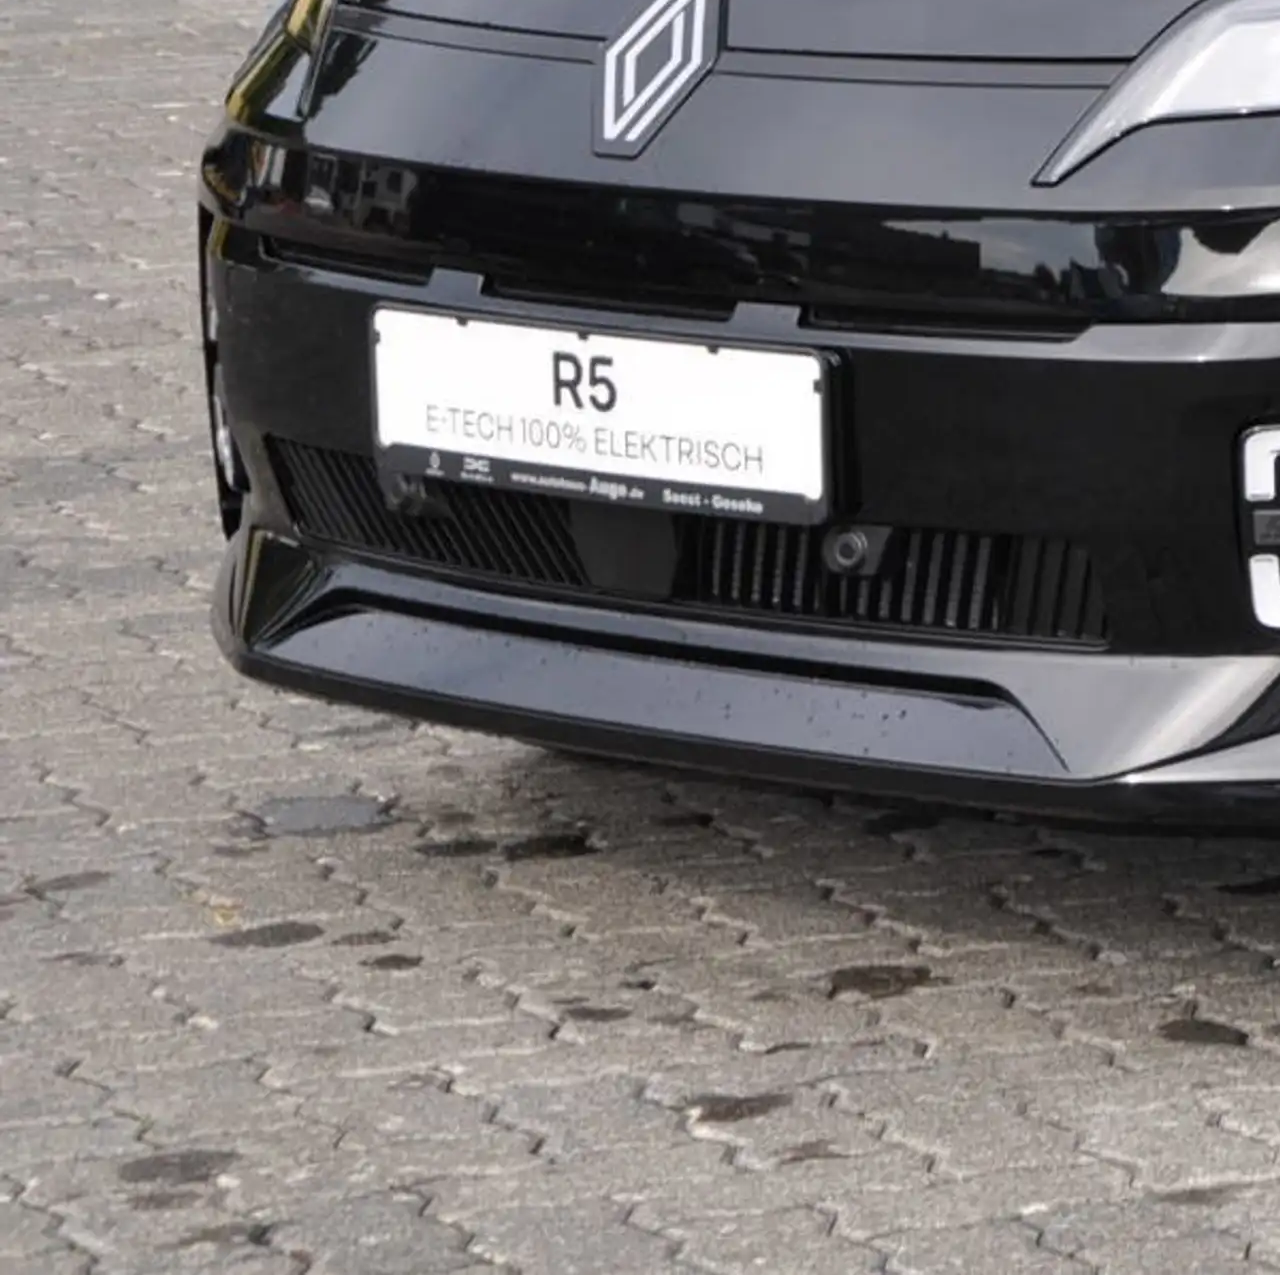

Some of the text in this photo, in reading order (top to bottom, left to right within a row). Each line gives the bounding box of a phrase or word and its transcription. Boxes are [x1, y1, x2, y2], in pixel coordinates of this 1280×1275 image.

[552, 350, 617, 413] R5
[426, 404, 764, 474] E-TECH 100% ELEKTRISCH
